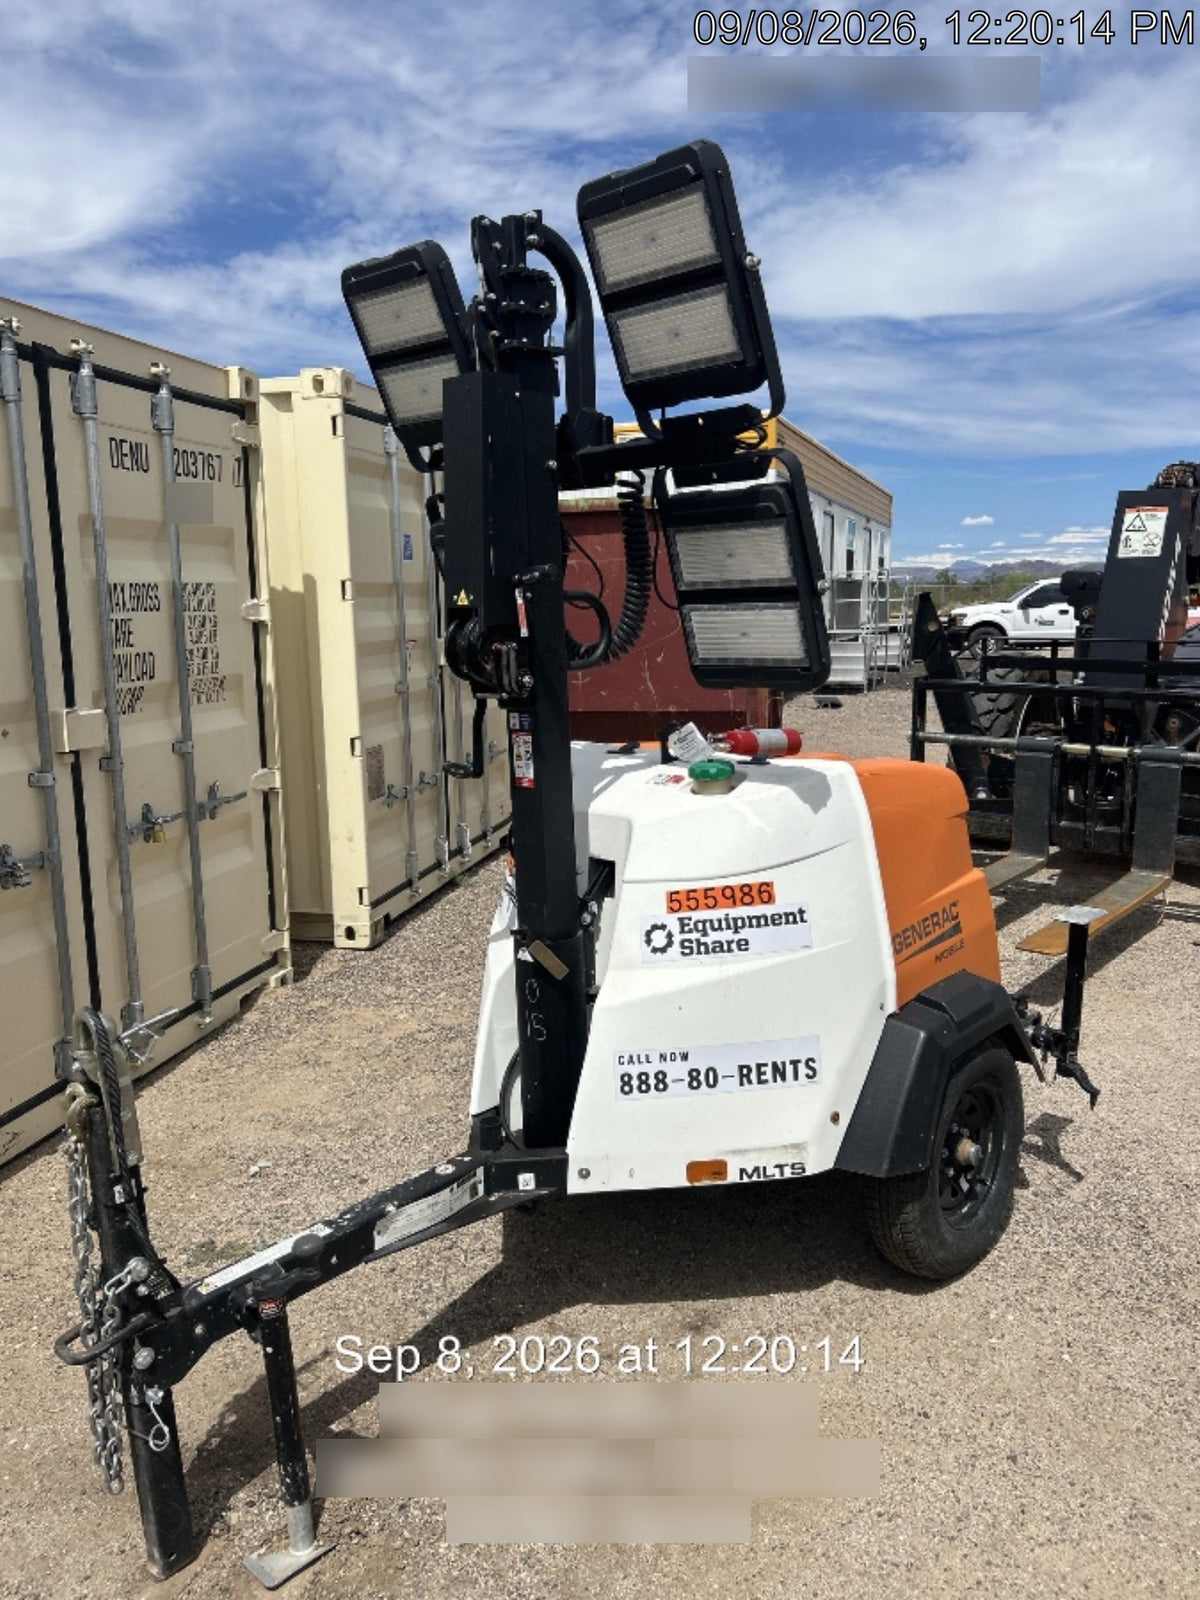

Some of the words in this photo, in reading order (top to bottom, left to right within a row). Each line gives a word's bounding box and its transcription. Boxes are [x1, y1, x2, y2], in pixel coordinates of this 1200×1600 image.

[109, 437, 150, 473] DENU
[173, 448, 223, 482] 203767
[113, 651, 156, 683] AYLOAD
[669, 881, 773, 913] 555986
[677, 907, 808, 937] Equipment
[892, 899, 960, 955] GENERAC
[679, 937, 750, 957] Share
[618, 1053, 652, 1066] CALL
[659, 1051, 690, 1063] NOW
[619, 1057, 818, 1096] 888-80-RENTS
[738, 1162, 807, 1181] MLTS
